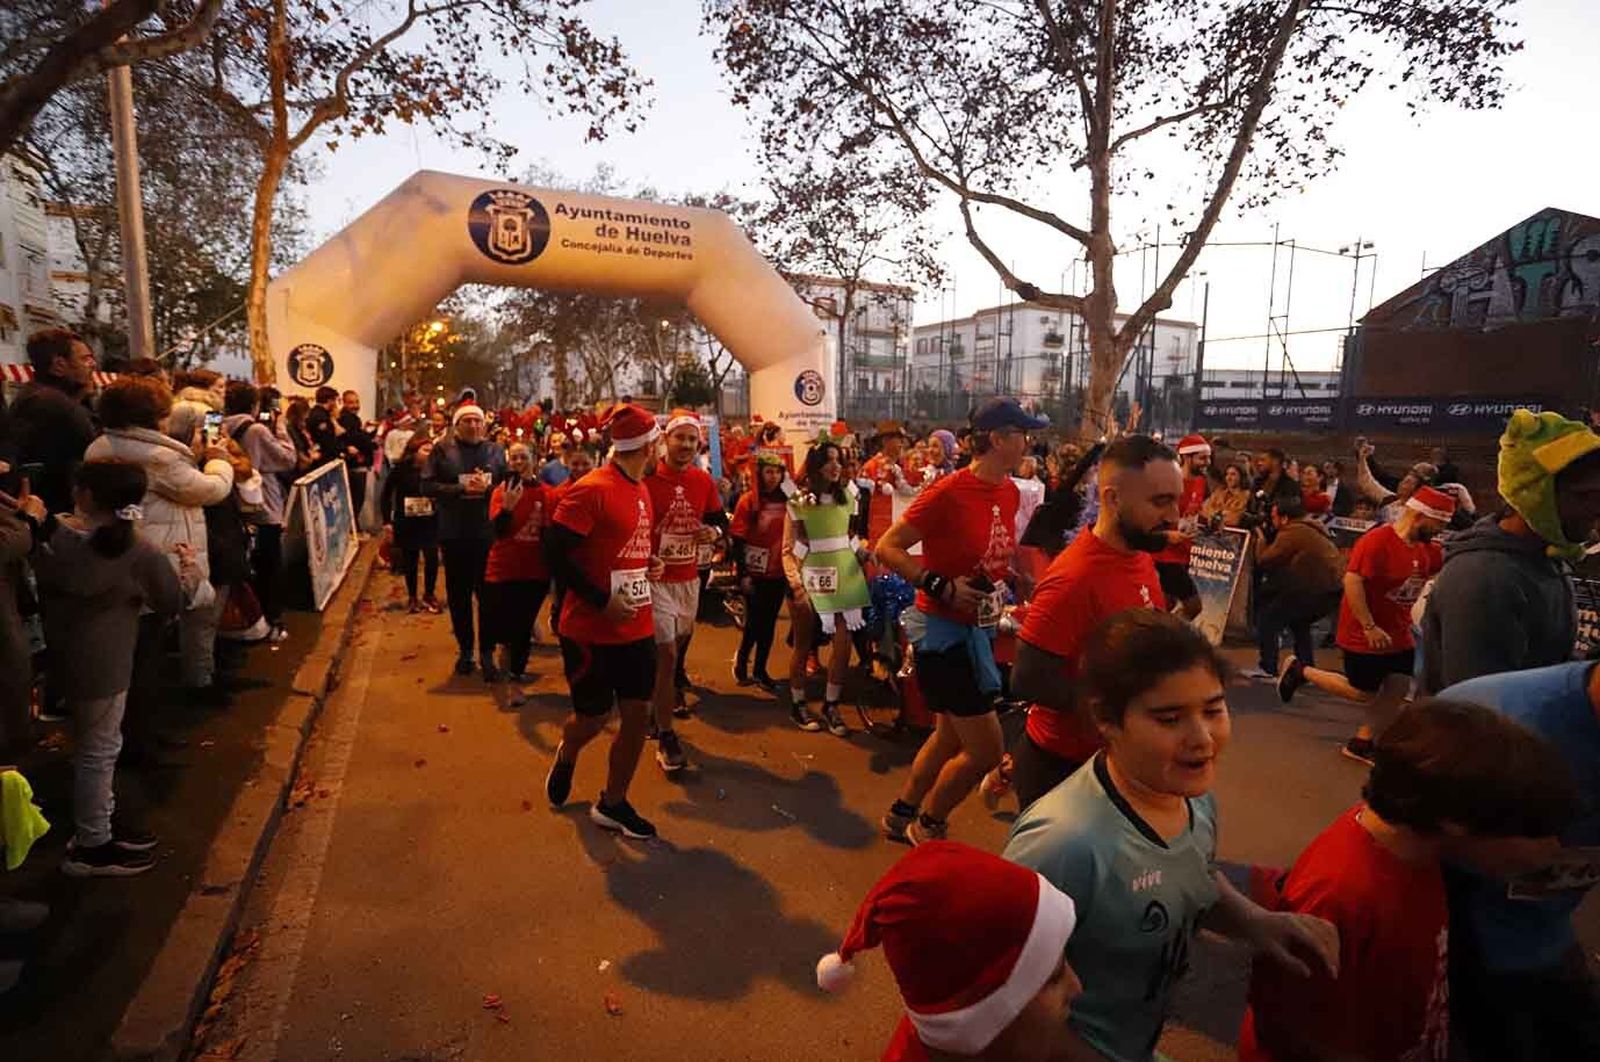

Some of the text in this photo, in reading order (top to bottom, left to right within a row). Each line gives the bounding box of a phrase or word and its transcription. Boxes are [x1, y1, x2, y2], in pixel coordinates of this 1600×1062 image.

[555, 203, 691, 230] Ayuntamiento
[595, 223, 691, 247] de Huelva
[626, 246, 640, 256] de
[643, 246, 693, 261] Deportes
[1377, 404, 1432, 415] HYUNDAI
